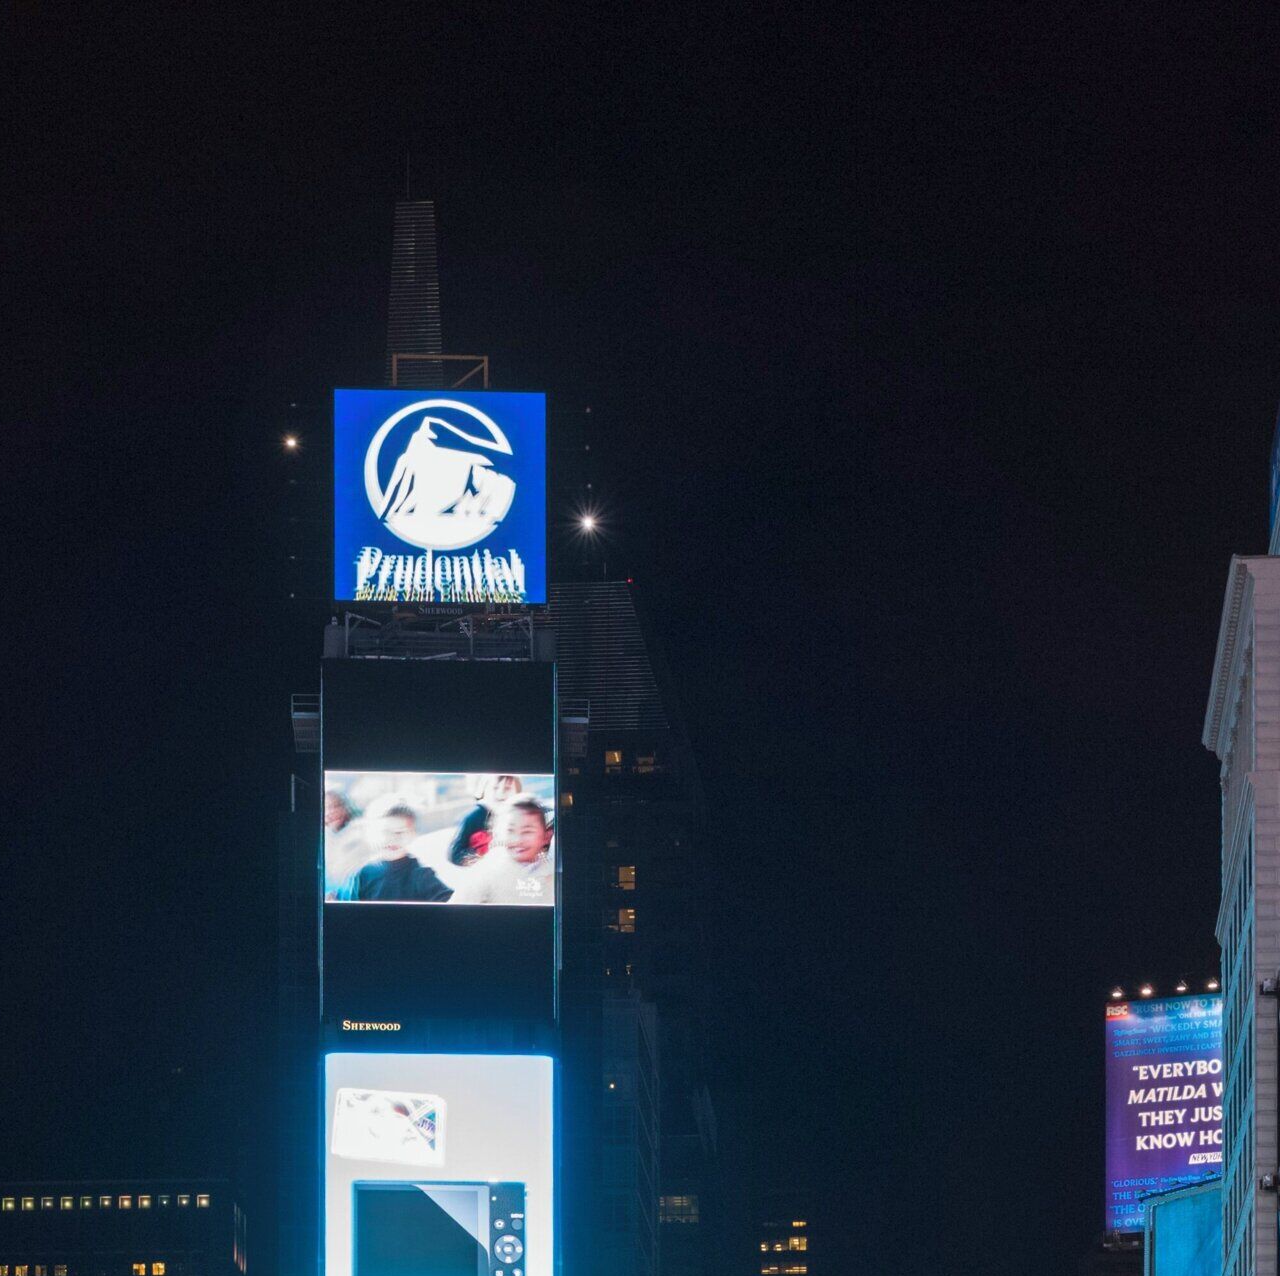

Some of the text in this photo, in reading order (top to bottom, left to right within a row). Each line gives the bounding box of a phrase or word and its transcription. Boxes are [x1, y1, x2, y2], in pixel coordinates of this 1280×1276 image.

[1106, 1005, 1128, 1016] RSC
[342, 1020, 401, 1031] SHERWOOD
[1127, 1084, 1206, 1104] MATILDA
[1138, 1109, 1184, 1127] THEY
[1136, 1133, 1193, 1151] KNOW
